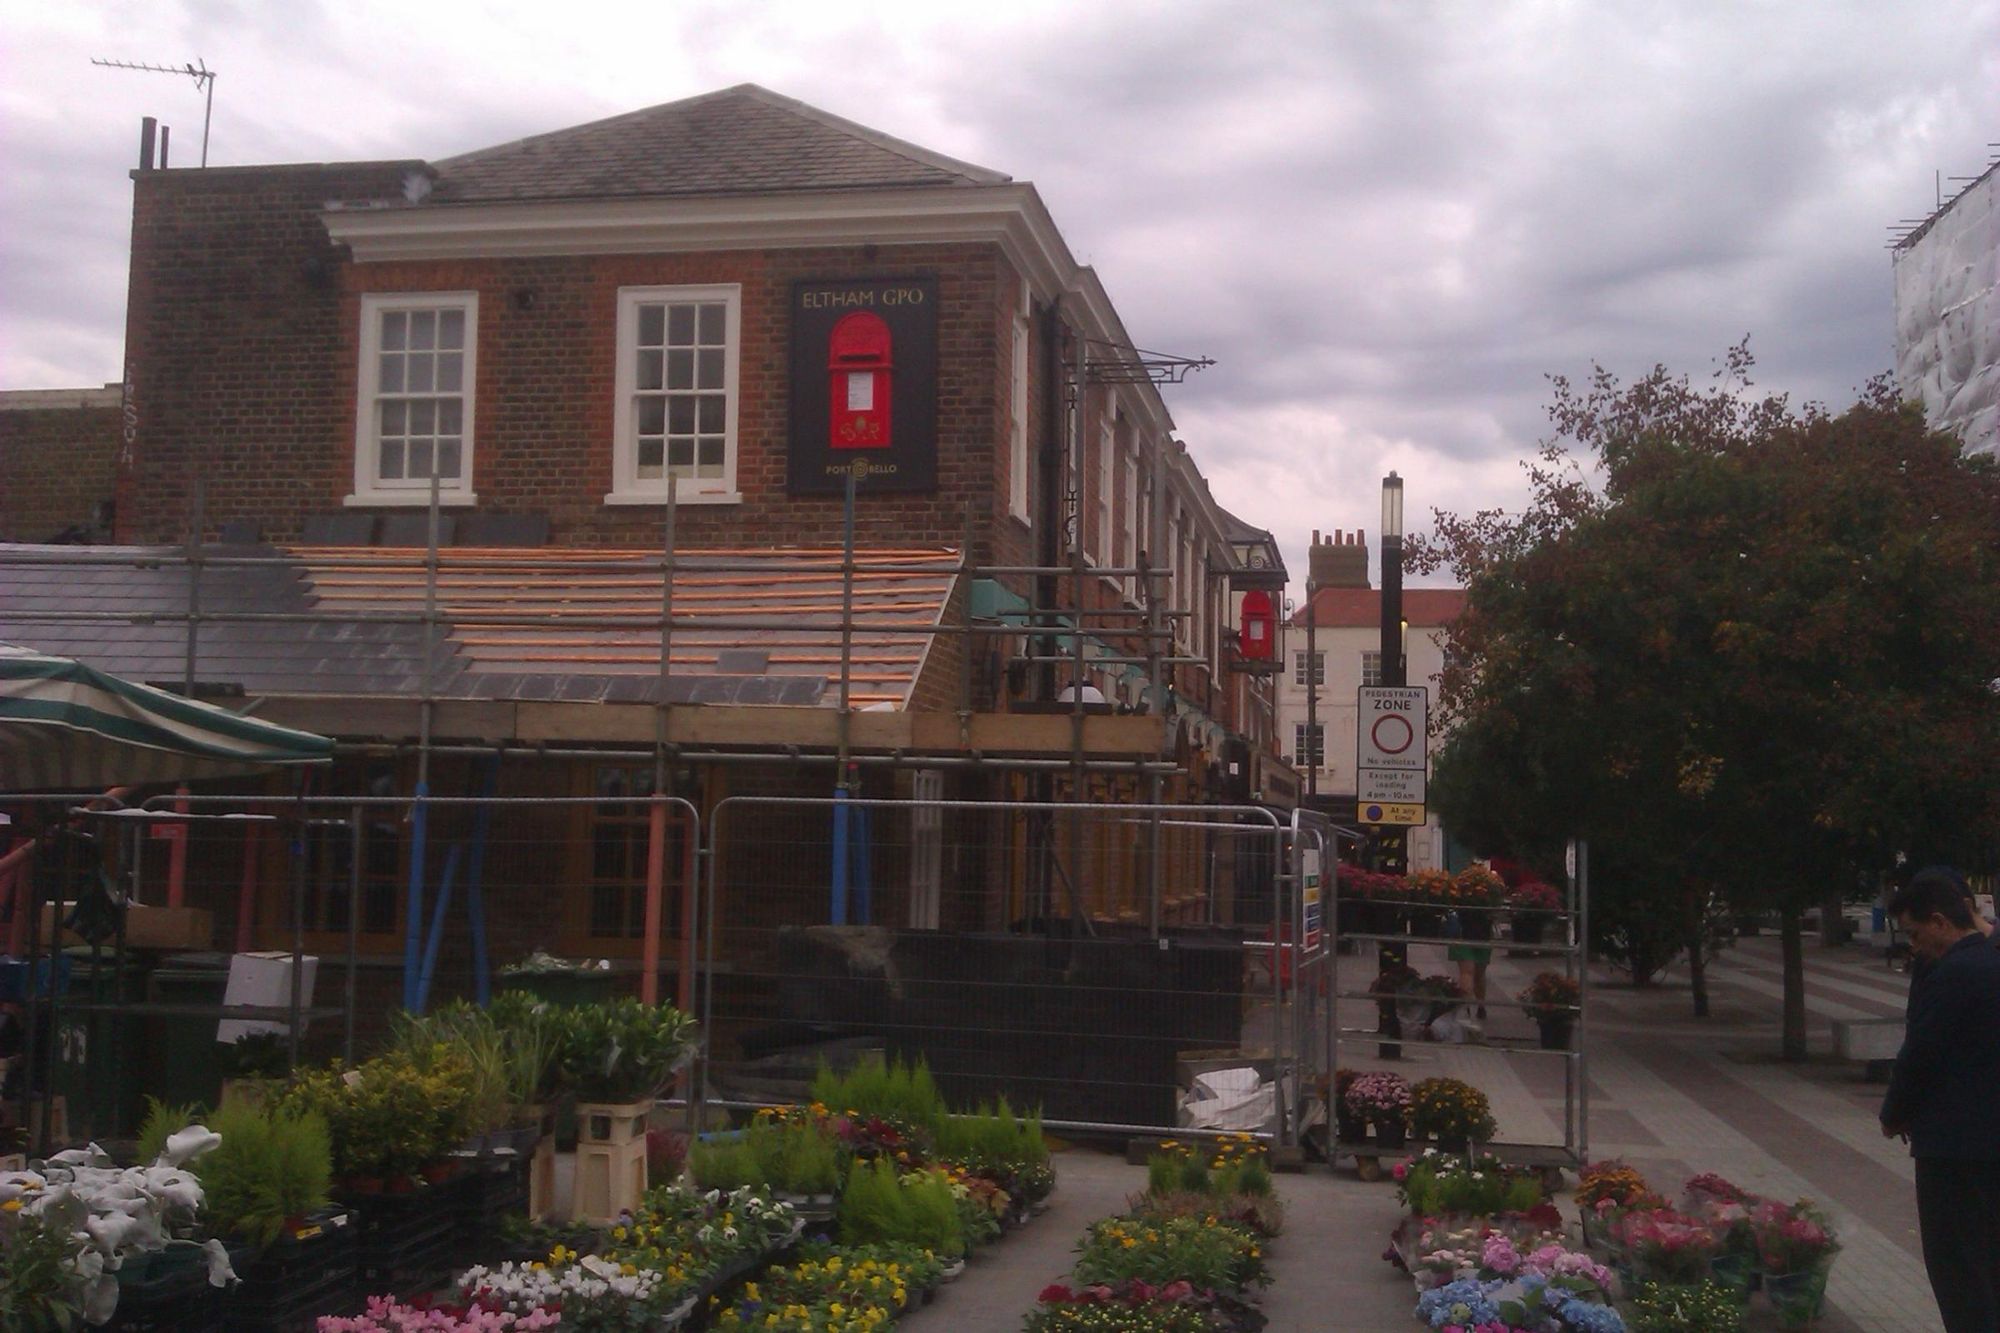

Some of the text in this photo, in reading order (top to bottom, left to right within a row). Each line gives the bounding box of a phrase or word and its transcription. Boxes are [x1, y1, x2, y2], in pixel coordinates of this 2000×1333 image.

[803, 288, 924, 309] ELTHAM GPO
[1365, 690, 1420, 698] PEDESTRIAN
[1374, 699, 1411, 710] ZONE
[1367, 757, 1416, 766] No vehicles
[1369, 771, 1413, 781] Except for
[1375, 781, 1406, 790] loading
[1391, 806, 1416, 816] At any
